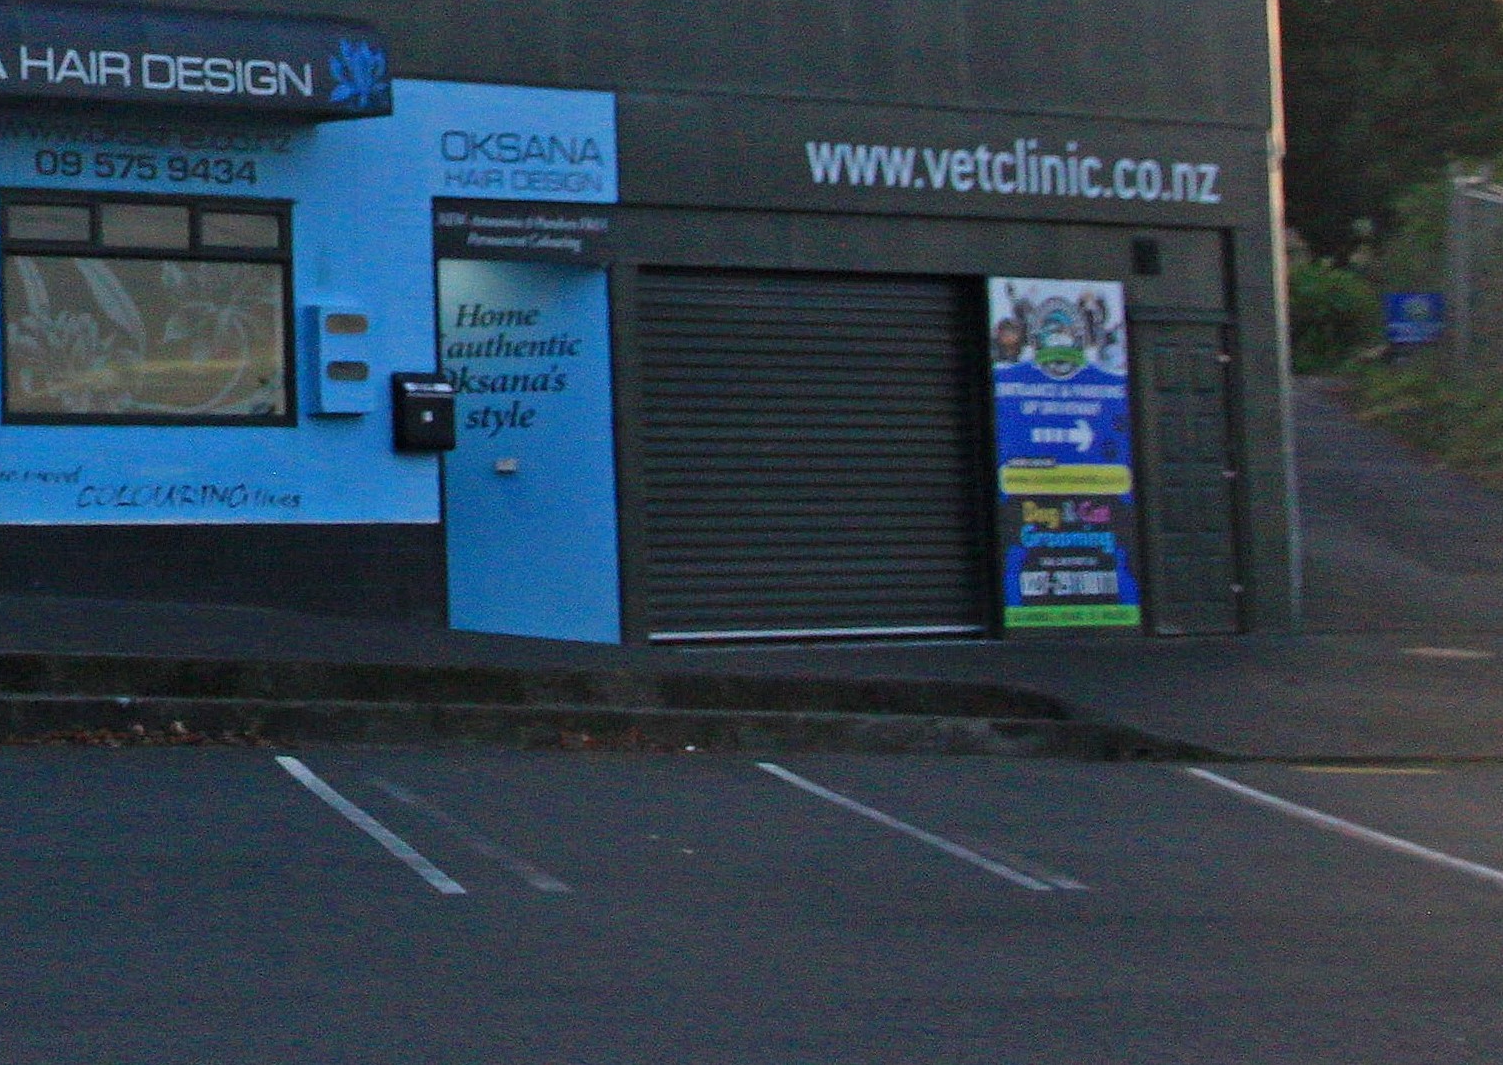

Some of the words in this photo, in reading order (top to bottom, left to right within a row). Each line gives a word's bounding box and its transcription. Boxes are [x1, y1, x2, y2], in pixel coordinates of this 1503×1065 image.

[20, 44, 132, 88] HAIR
[142, 53, 313, 98] DESIGN
[34, 148, 83, 177] 09
[94, 151, 158, 181] 575
[167, 155, 259, 185] 9434
[441, 130, 604, 166] OKSANA
[805, 139, 1221, 205] www.vetclinic.co.nz
[455, 302, 541, 329] Home
[446, 333, 583, 359] authentic
[465, 399, 537, 438] style
